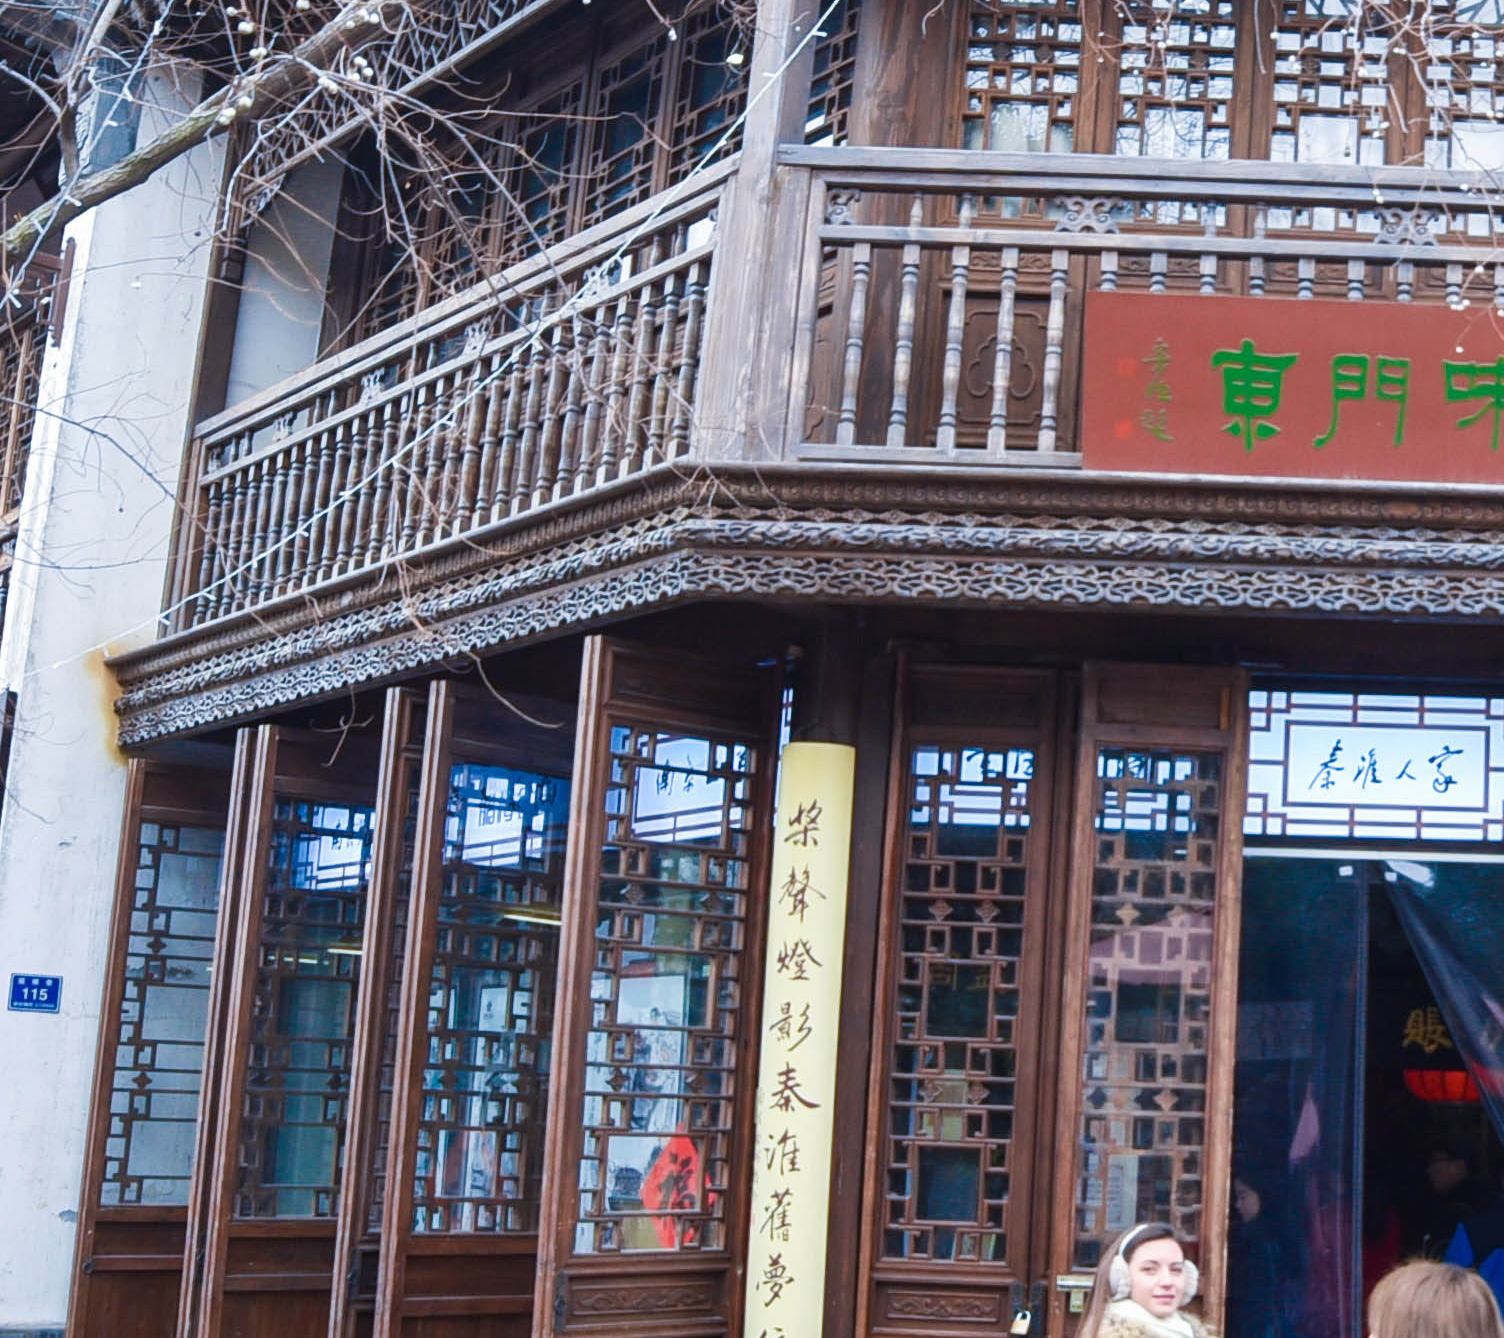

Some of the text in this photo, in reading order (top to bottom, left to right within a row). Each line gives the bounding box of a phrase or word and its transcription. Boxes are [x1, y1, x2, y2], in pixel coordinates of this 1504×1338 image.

[1309, 739, 1464, 793] 秦淮人家
[22, 987, 48, 1001] 115
